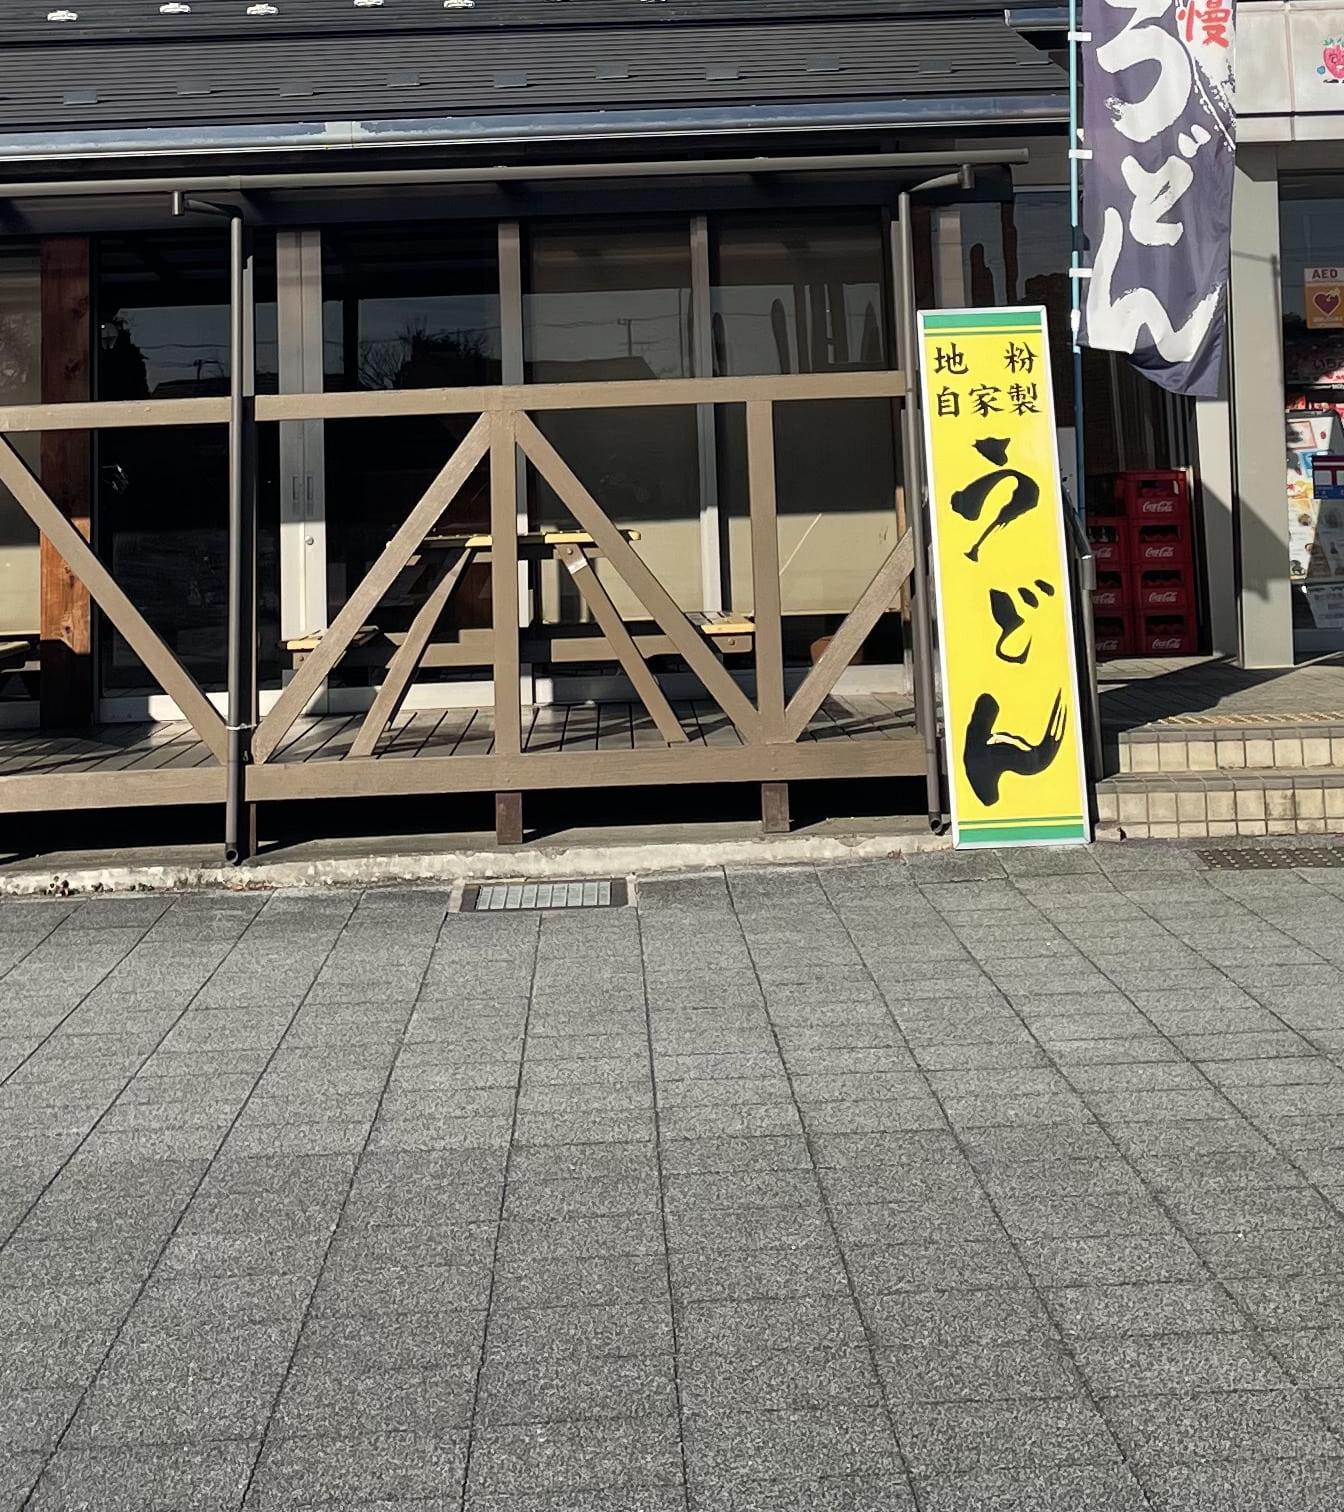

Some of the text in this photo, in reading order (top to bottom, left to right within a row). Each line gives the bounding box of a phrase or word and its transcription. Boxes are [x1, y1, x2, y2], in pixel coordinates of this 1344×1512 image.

[1311, 268, 1339, 280] AED
[936, 382, 1043, 418] 自家製
[951, 436, 1068, 807] うどん
